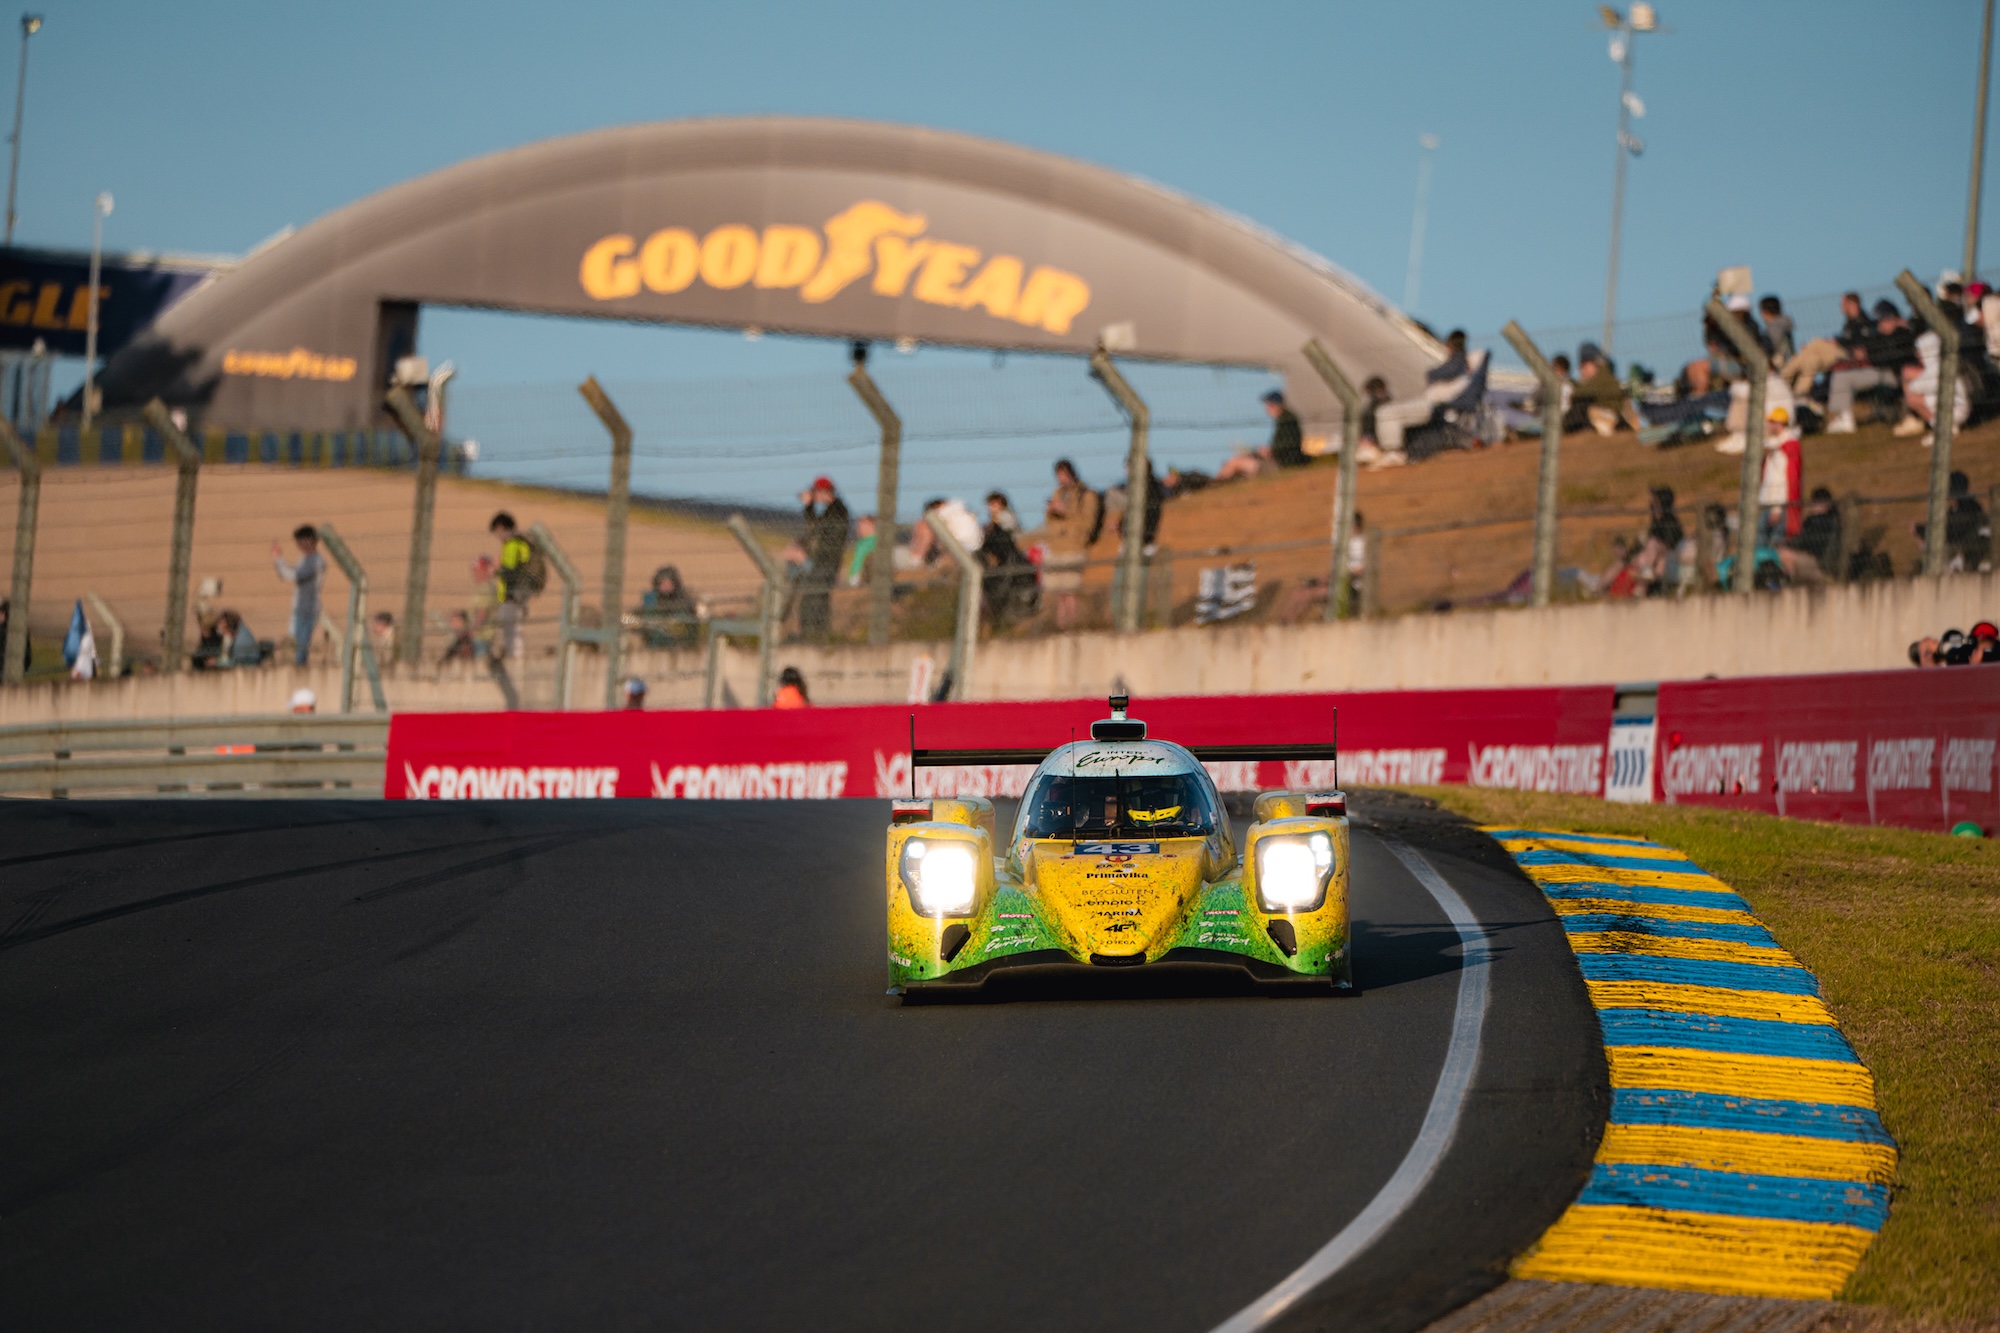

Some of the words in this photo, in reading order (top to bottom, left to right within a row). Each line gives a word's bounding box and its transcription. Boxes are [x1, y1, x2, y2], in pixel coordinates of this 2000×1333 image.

[580, 203, 1092, 335] GOODYEAR
[421, 766, 618, 800] CROWDSTRIKE
[666, 761, 848, 799] CROWDSTRIKE
[1476, 744, 1603, 794] CROWDSTRIKE
[1669, 743, 1762, 794] CROWDSTRIKE
[1781, 741, 1858, 792] CROWDSTRIKE
[1872, 737, 1935, 790] CROWDSTRIKE
[1083, 843, 1151, 854] 43
